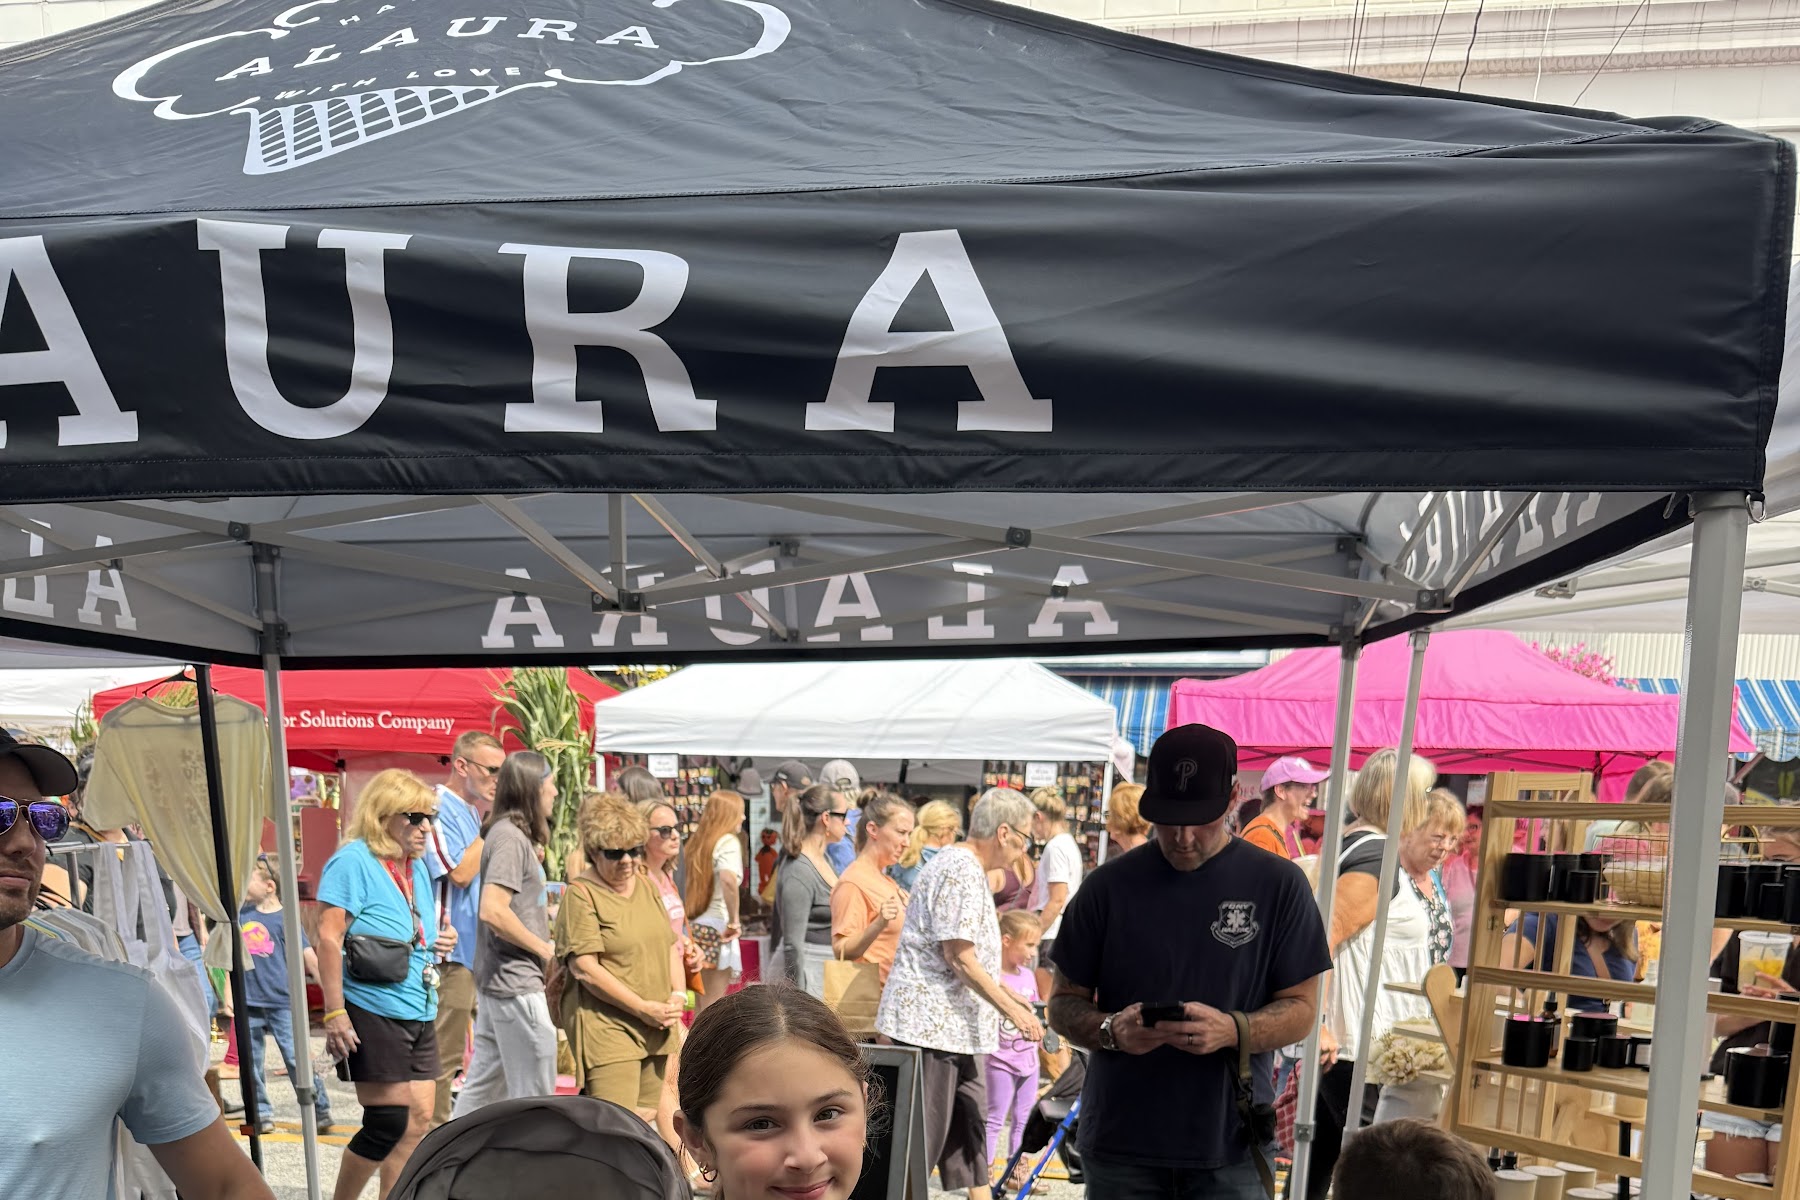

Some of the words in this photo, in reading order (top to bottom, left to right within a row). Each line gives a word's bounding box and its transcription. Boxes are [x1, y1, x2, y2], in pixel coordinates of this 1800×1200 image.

[215, 16, 660, 82] ALAURA
[274, 77, 377, 100] WITH
[406, 66, 521, 79] LOVE
[0, 218, 1053, 448] AURA
[299, 709, 374, 729] Solutions
[377, 711, 455, 735] Company
